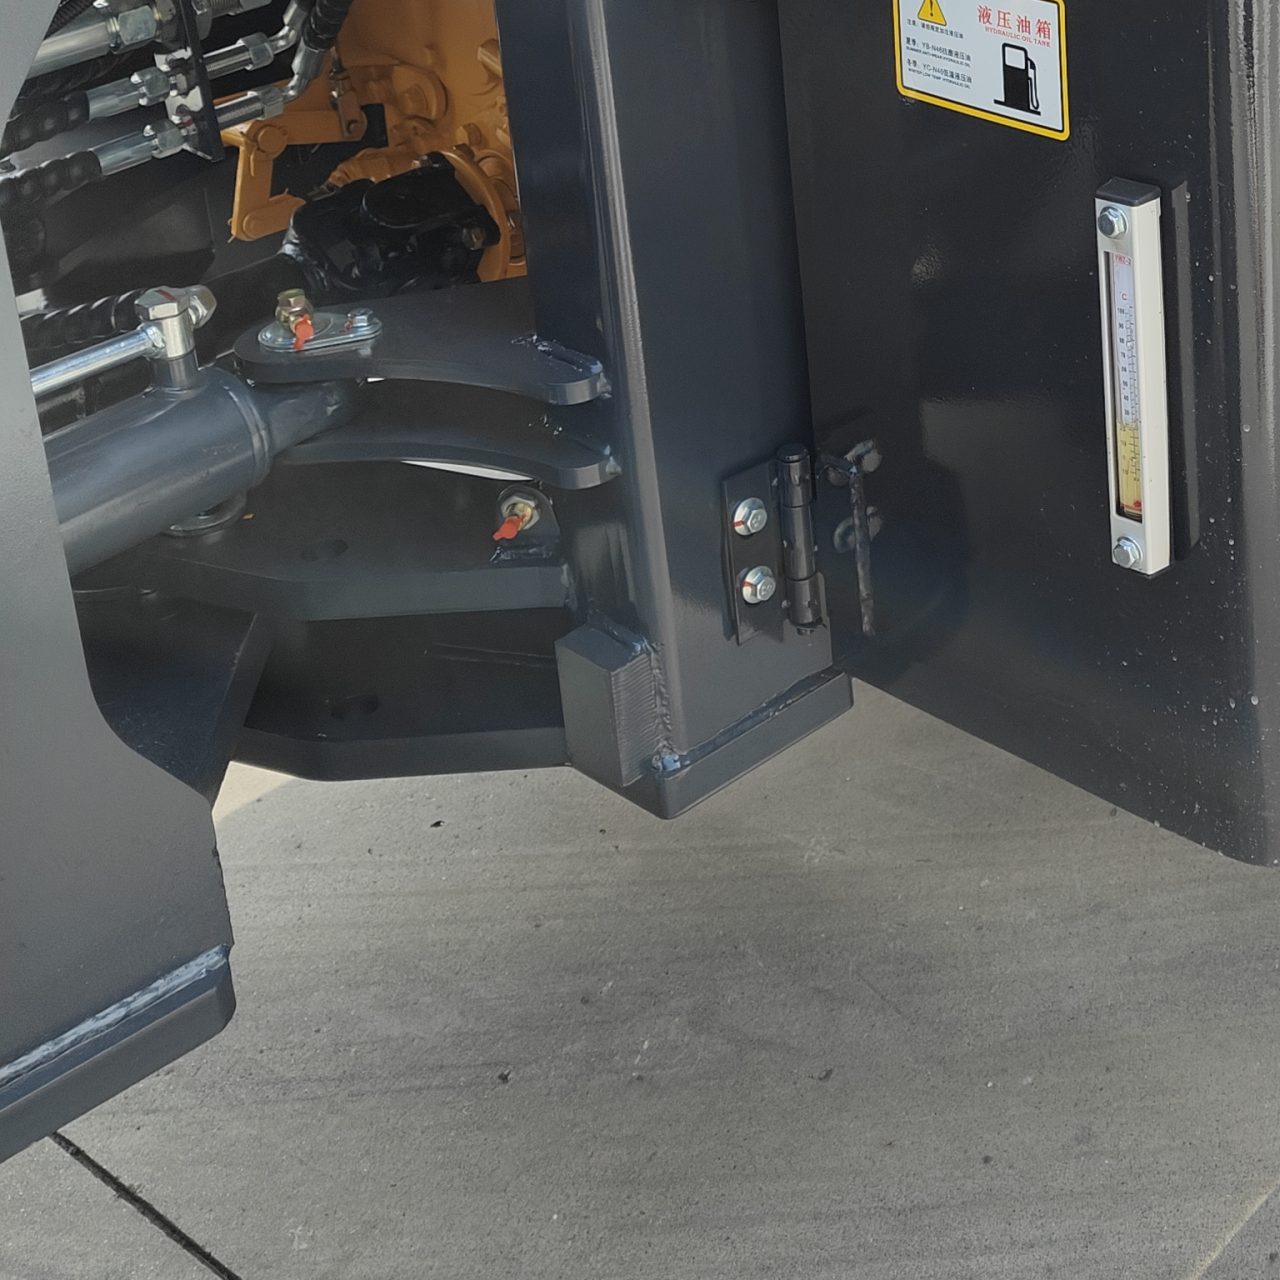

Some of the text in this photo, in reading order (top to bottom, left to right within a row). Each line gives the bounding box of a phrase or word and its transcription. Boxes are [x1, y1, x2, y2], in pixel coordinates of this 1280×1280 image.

[977, 4, 1052, 40] 液压油箱
[1021, 35, 1033, 43] OIL
